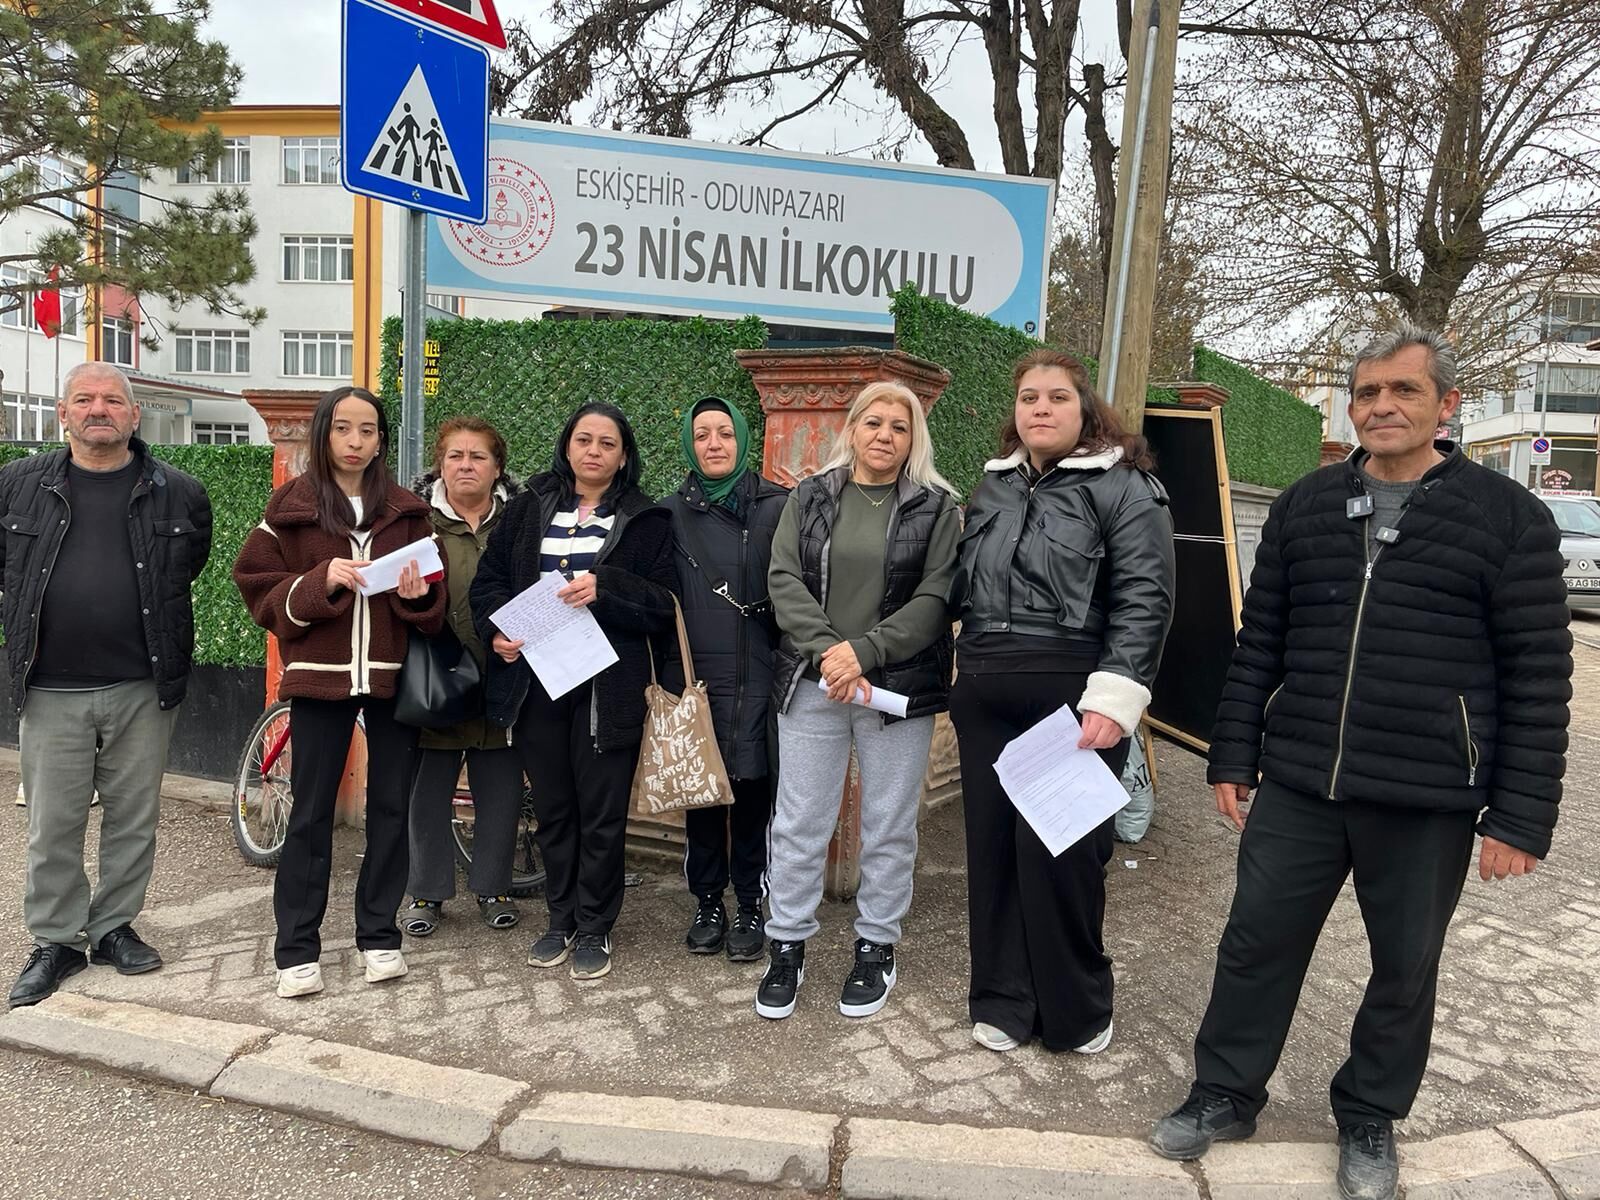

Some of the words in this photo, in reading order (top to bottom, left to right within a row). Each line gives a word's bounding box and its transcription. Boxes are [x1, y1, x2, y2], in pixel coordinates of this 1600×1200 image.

[576, 166, 685, 210] ESKİŞEHİR
[704, 181, 845, 223] ODUNPAZARI
[574, 222, 625, 276] 23
[638, 216, 768, 288] NİSAN
[780, 226, 975, 305] İLKOKULU
[1575, 579, 1589, 588] AG
